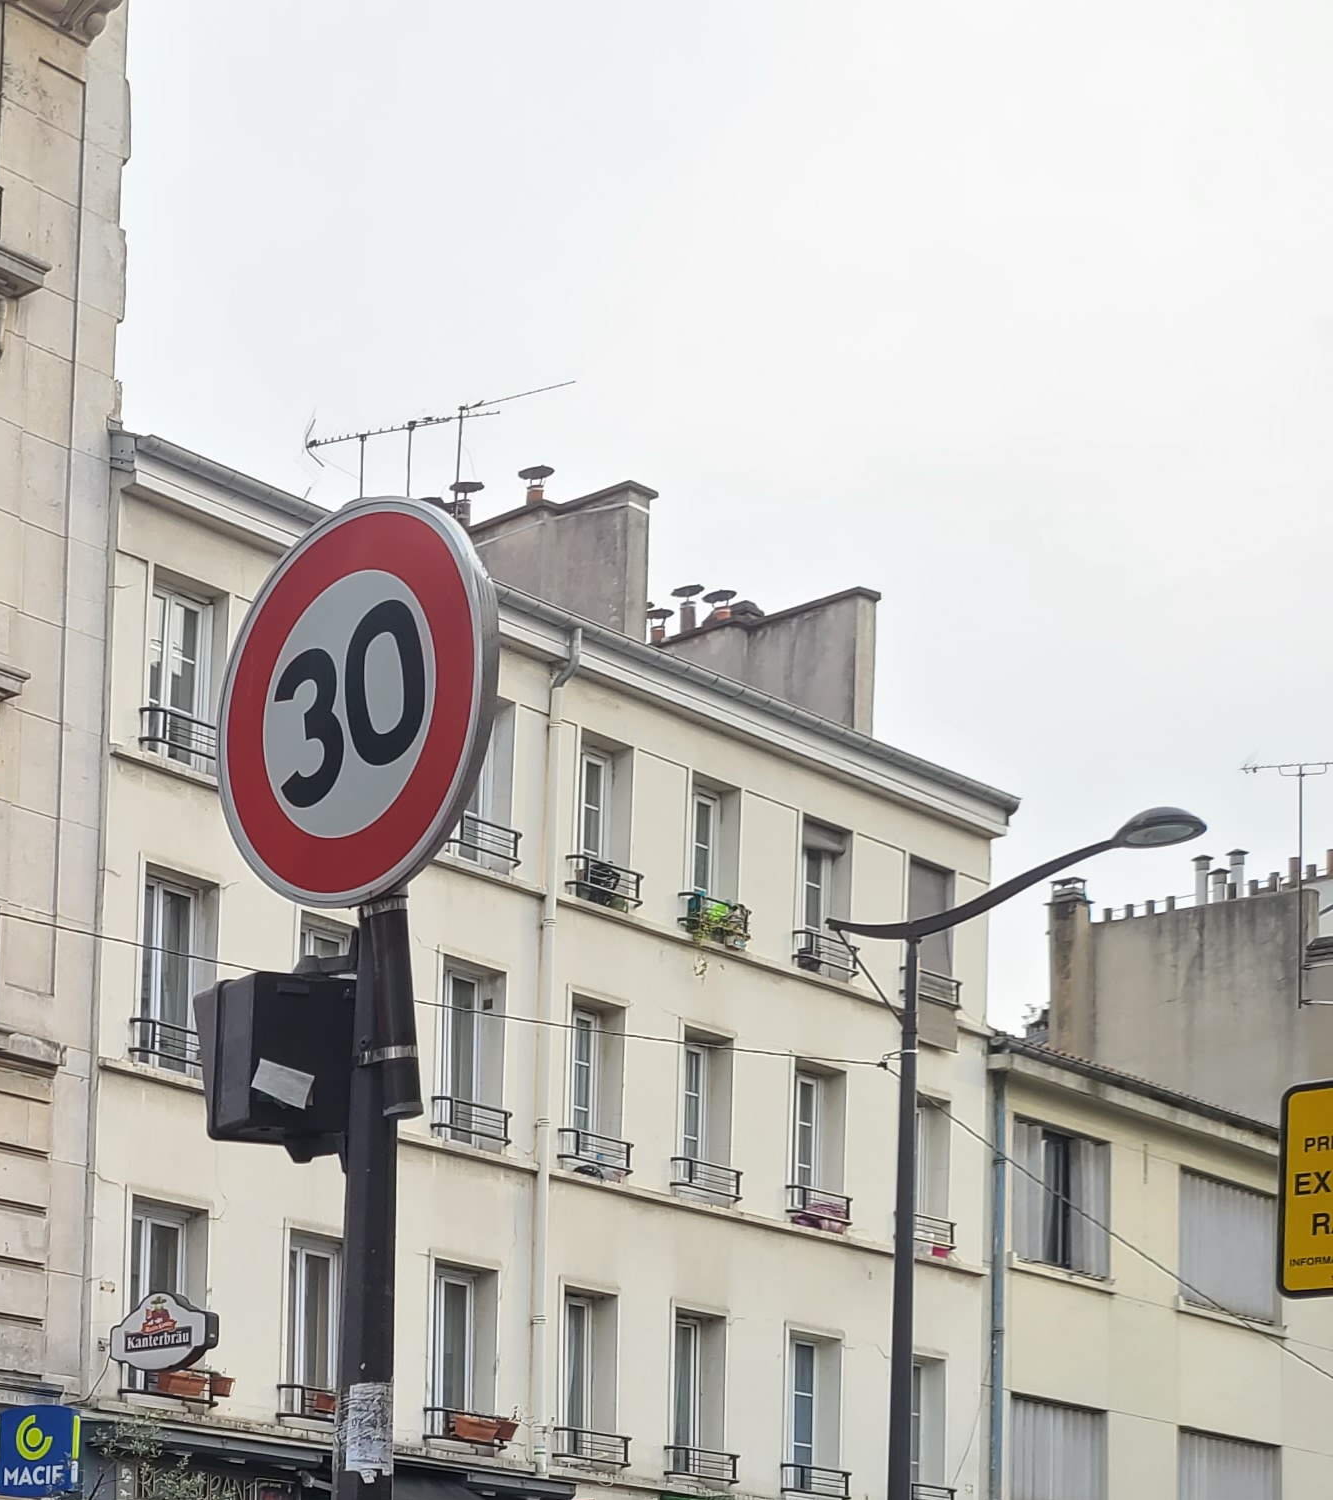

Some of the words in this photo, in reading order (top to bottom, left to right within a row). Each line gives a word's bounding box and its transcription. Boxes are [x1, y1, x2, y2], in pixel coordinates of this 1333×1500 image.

[274, 598, 426, 808] 30
[1311, 1212, 1333, 1236] R
[126, 1331, 190, 1350] Kanterbräu
[3, 1465, 64, 1486] MACIF
